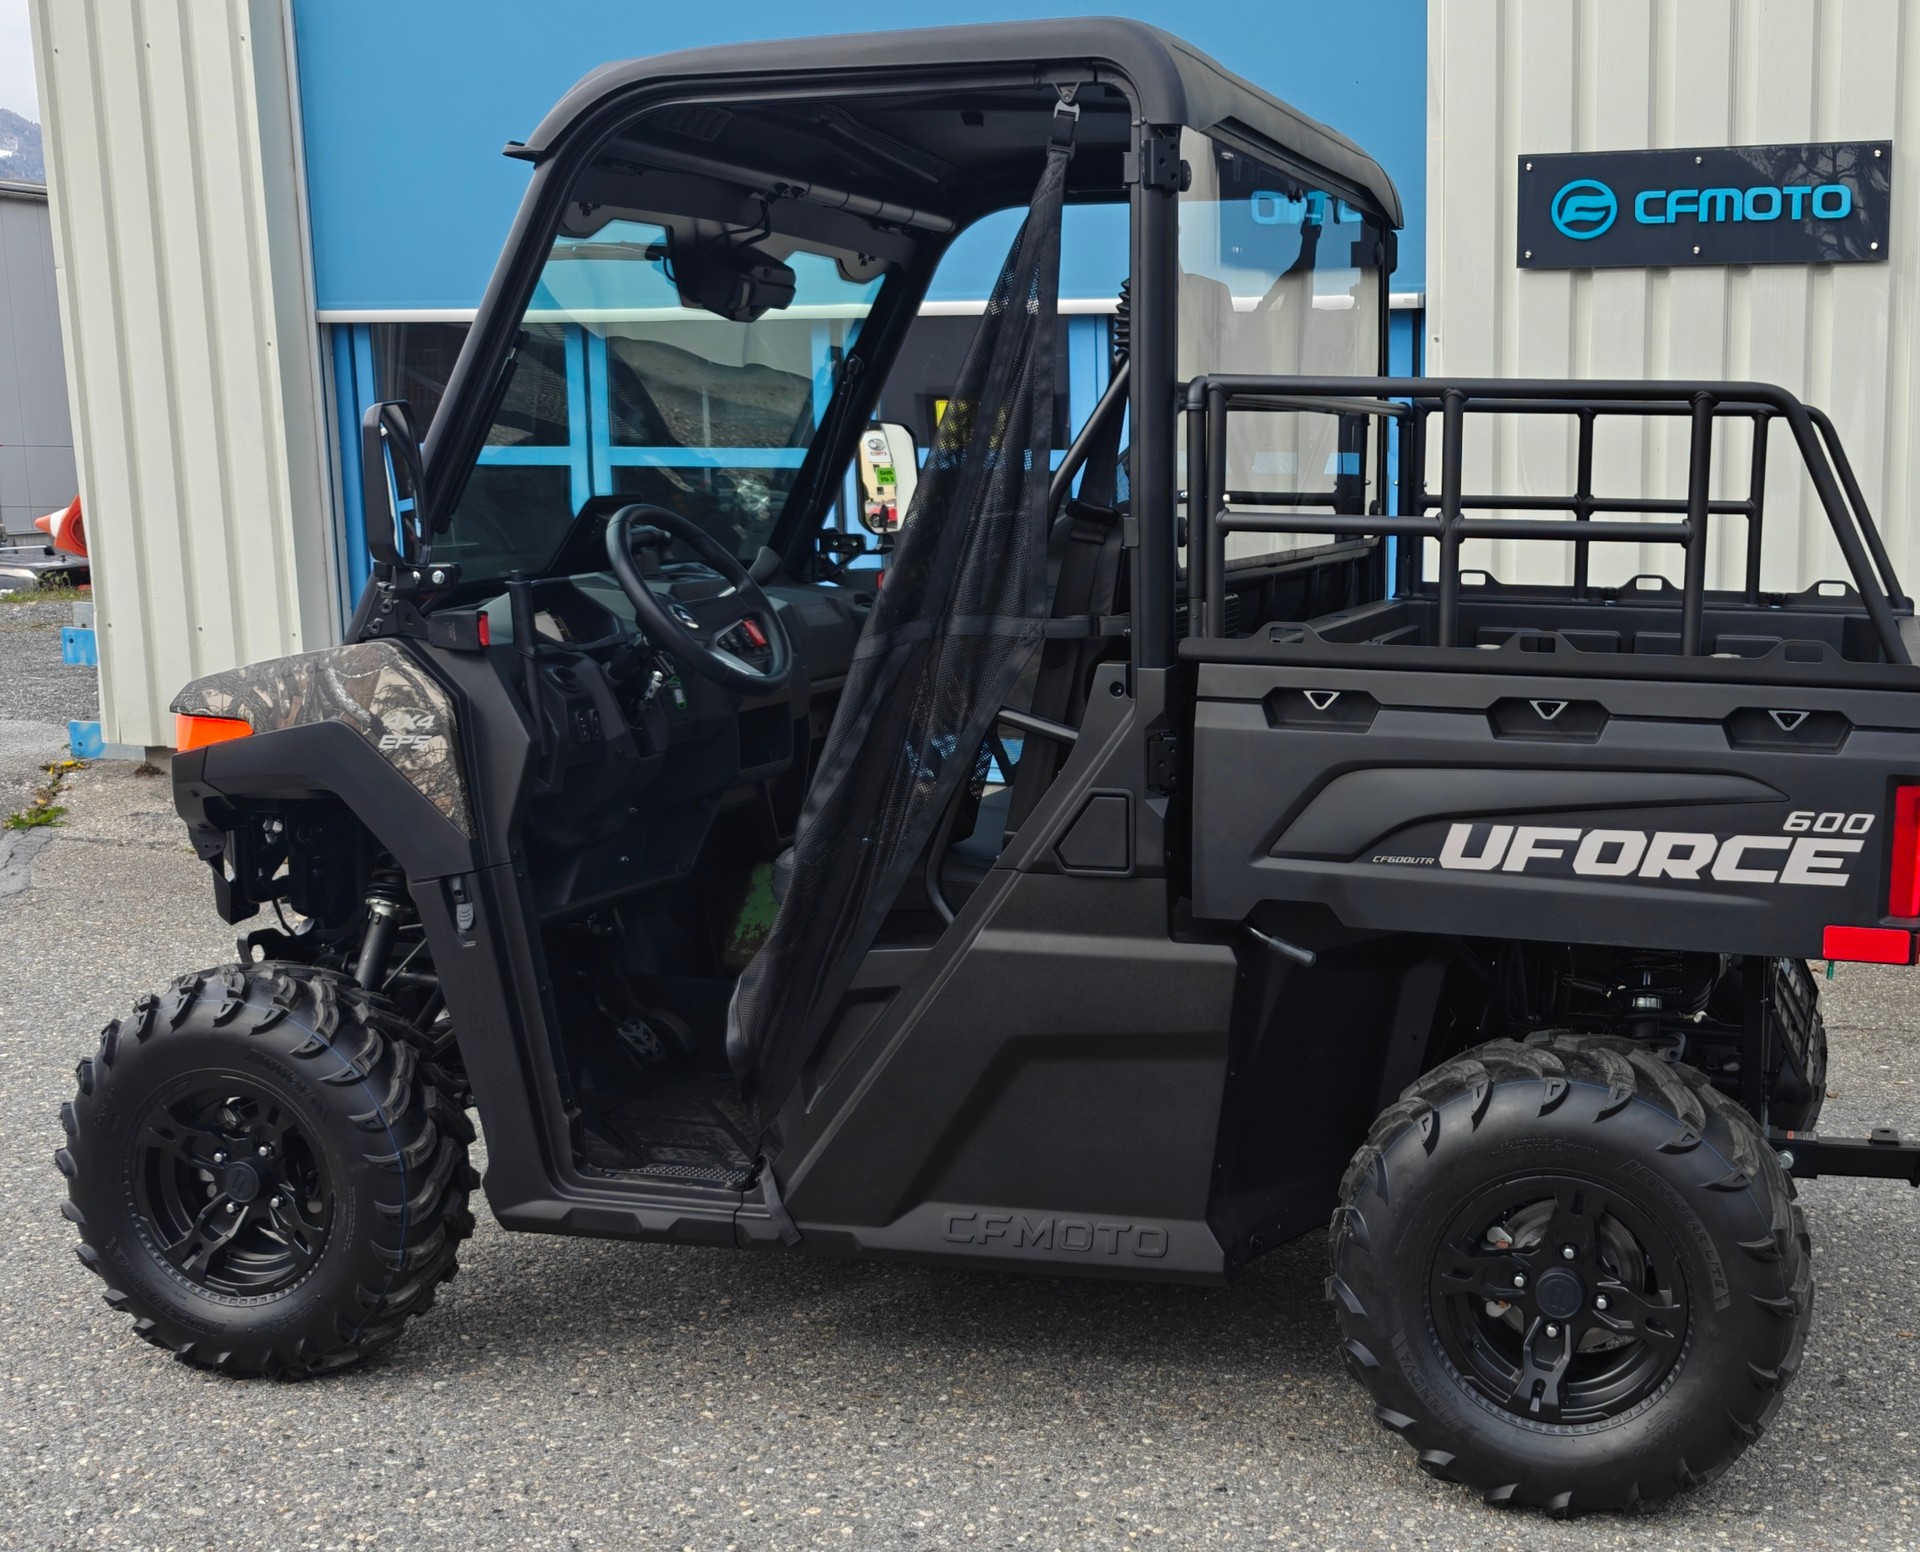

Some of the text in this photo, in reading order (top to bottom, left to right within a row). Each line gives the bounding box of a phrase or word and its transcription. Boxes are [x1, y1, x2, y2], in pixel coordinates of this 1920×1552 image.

[1634, 184, 1853, 225] CFMOTO
[378, 734, 433, 750] EPS
[1782, 810, 1875, 833] 600
[1371, 855, 1435, 865] CF600UTR
[1439, 822, 1865, 886] UFORCE
[942, 1211, 1169, 1259] CFMOTO
